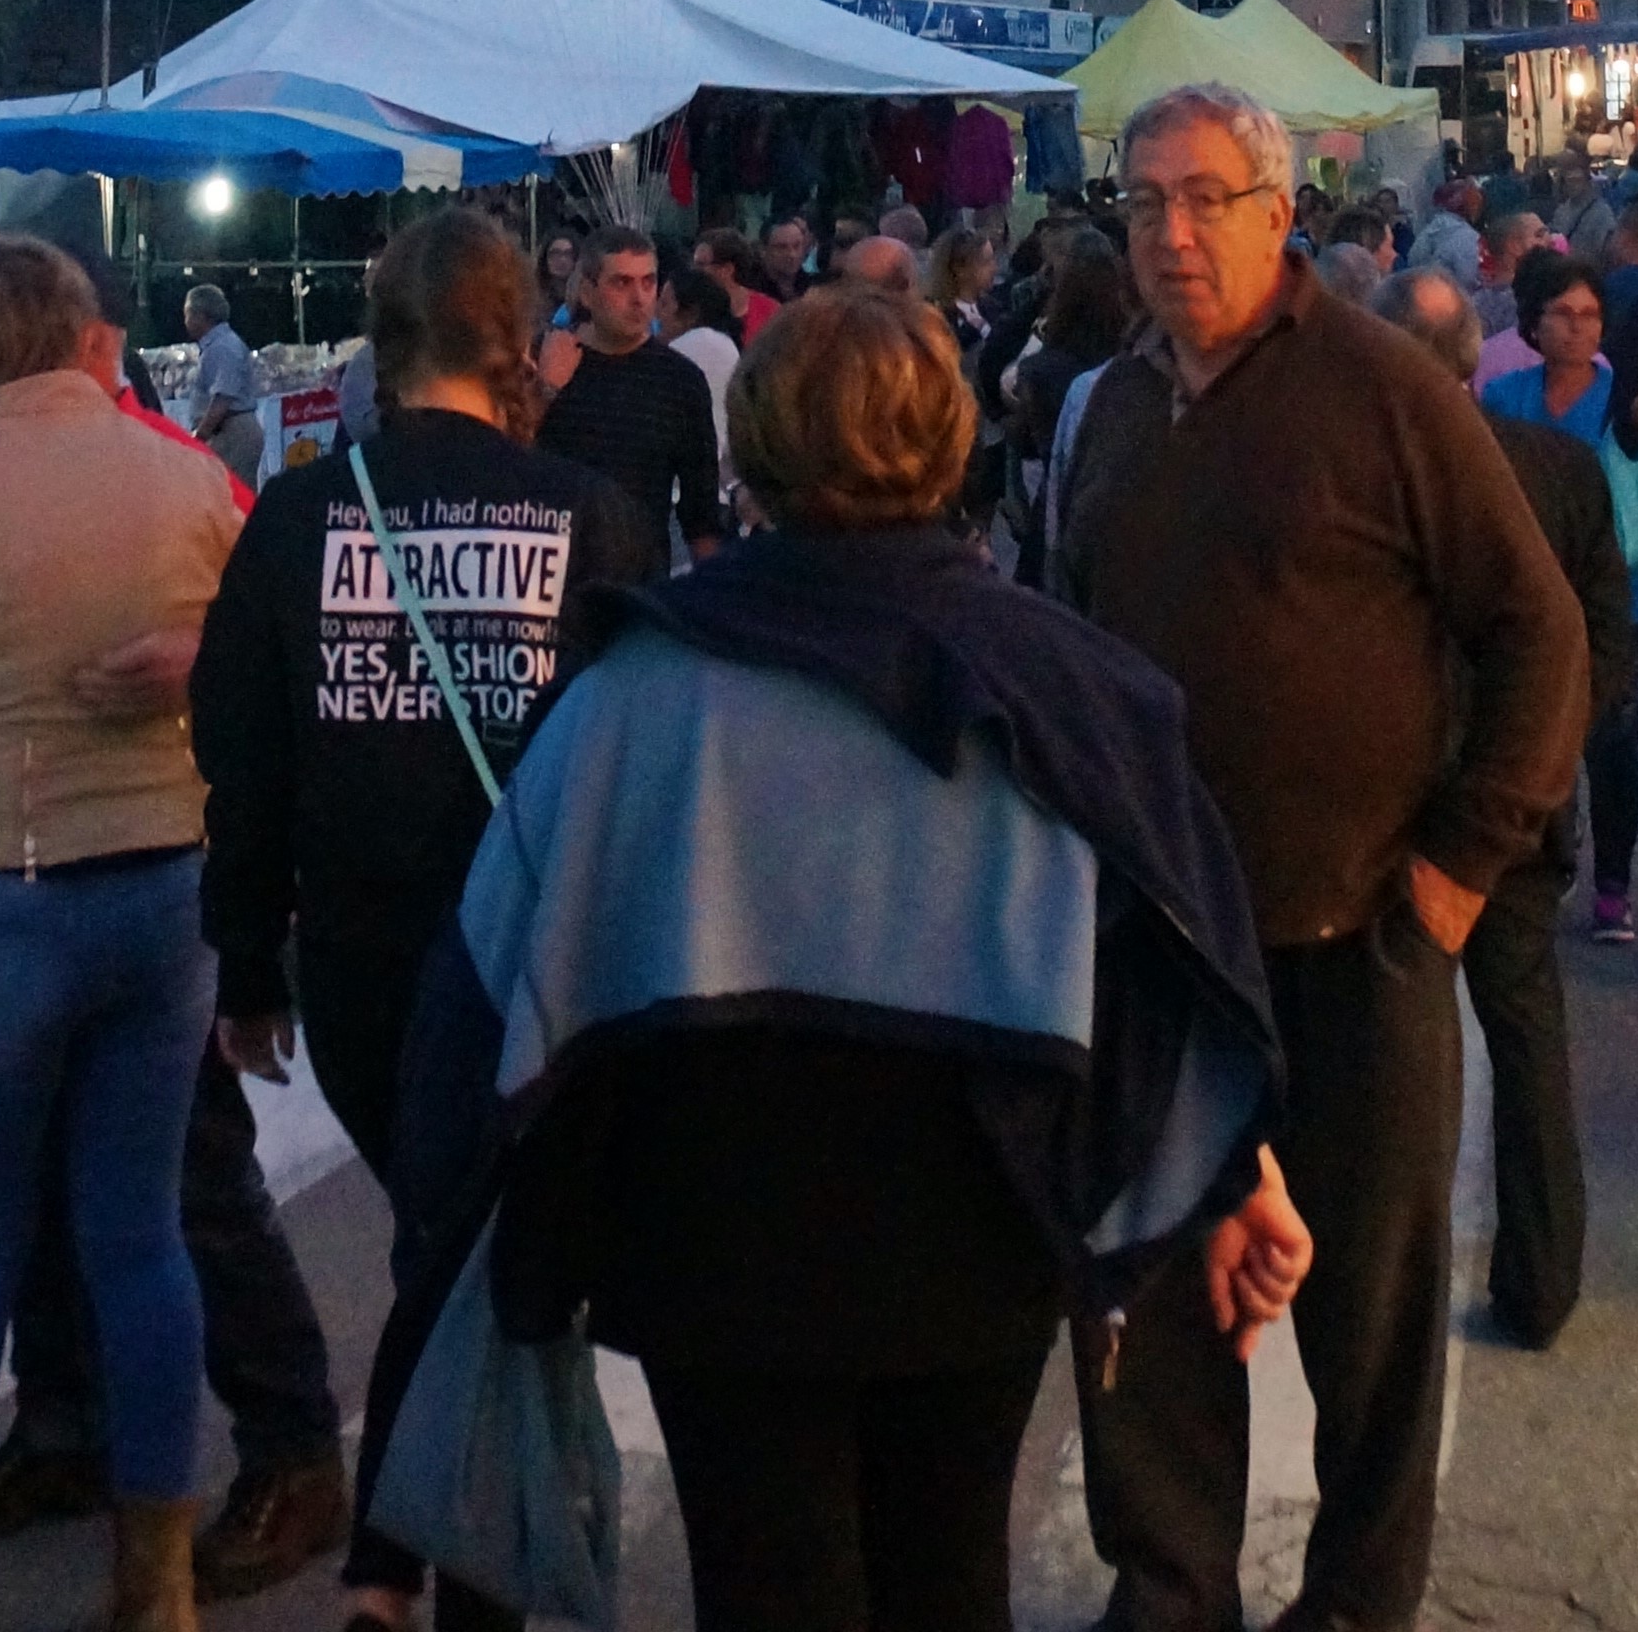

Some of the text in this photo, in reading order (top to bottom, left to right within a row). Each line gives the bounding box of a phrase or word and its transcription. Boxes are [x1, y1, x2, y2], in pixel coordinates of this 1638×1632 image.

[422, 499, 429, 525] I
[435, 498, 478, 524] had
[483, 499, 572, 534] nothing
[320, 618, 340, 638] to
[346, 618, 398, 639] wear.
[473, 619, 503, 638] me
[317, 681, 442, 722] NEVER
